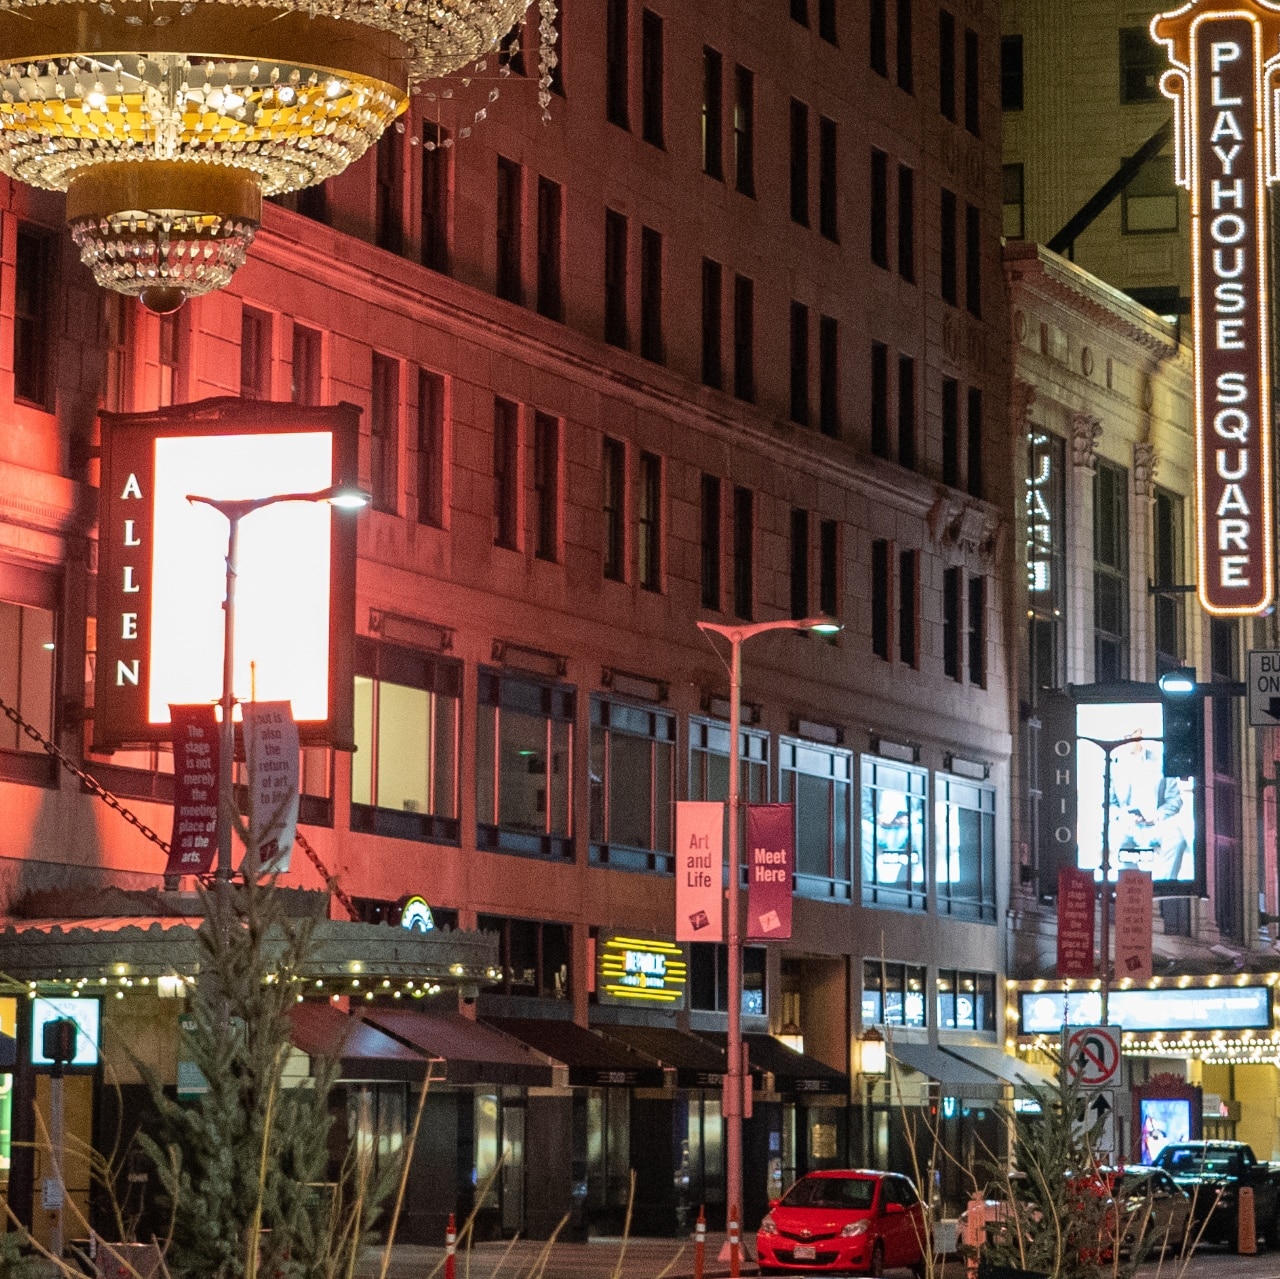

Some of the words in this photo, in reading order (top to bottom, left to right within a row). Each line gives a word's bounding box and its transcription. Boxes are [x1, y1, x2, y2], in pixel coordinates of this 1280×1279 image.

[1210, 41, 1246, 350] PLAYHOUSE
[1213, 372, 1251, 587] SQUARE
[116, 473, 143, 686] ALLEN
[1054, 740, 1071, 843] OHIO
[689, 833, 709, 849] Art
[687, 853, 712, 868] and
[754, 848, 787, 864] Meet
[687, 871, 712, 887] Life
[755, 866, 786, 882] Here
